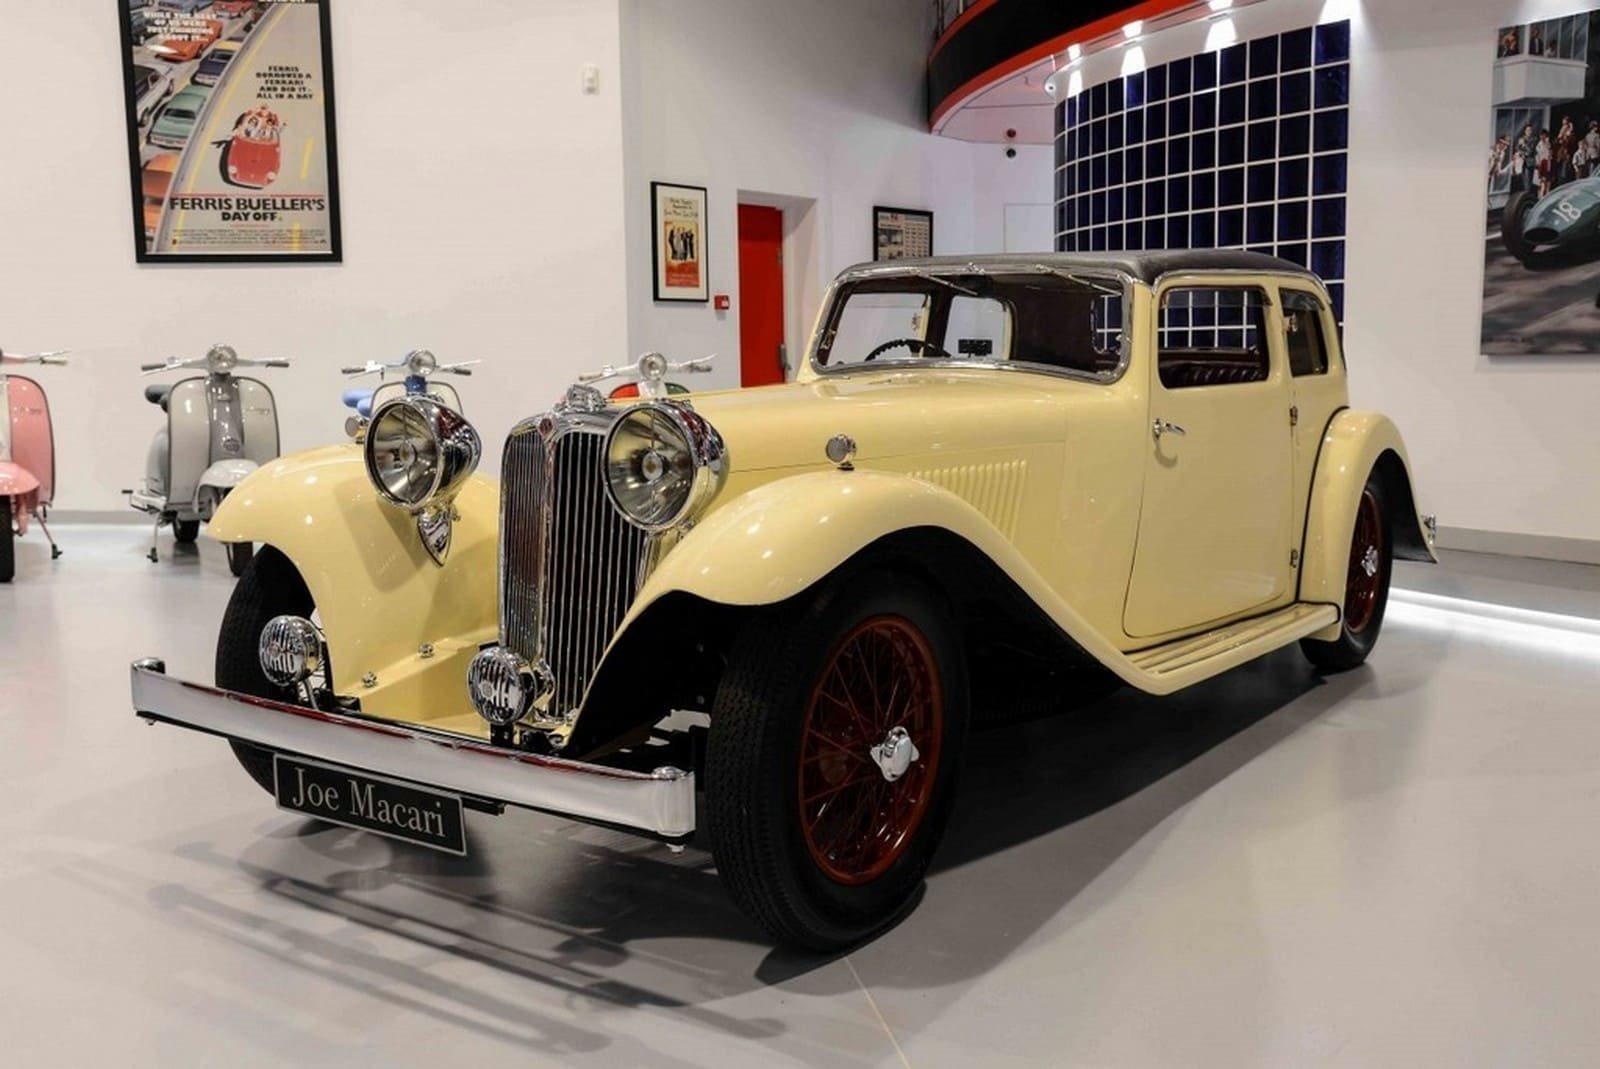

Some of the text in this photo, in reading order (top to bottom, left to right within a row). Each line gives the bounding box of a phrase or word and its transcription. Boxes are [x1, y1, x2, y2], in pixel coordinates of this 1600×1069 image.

[169, 197, 325, 211] FERRIS BUELLER'S
[1552, 201, 1582, 222] 18
[221, 212, 278, 221] DAY OFF
[292, 767, 446, 838] Joe Macari
